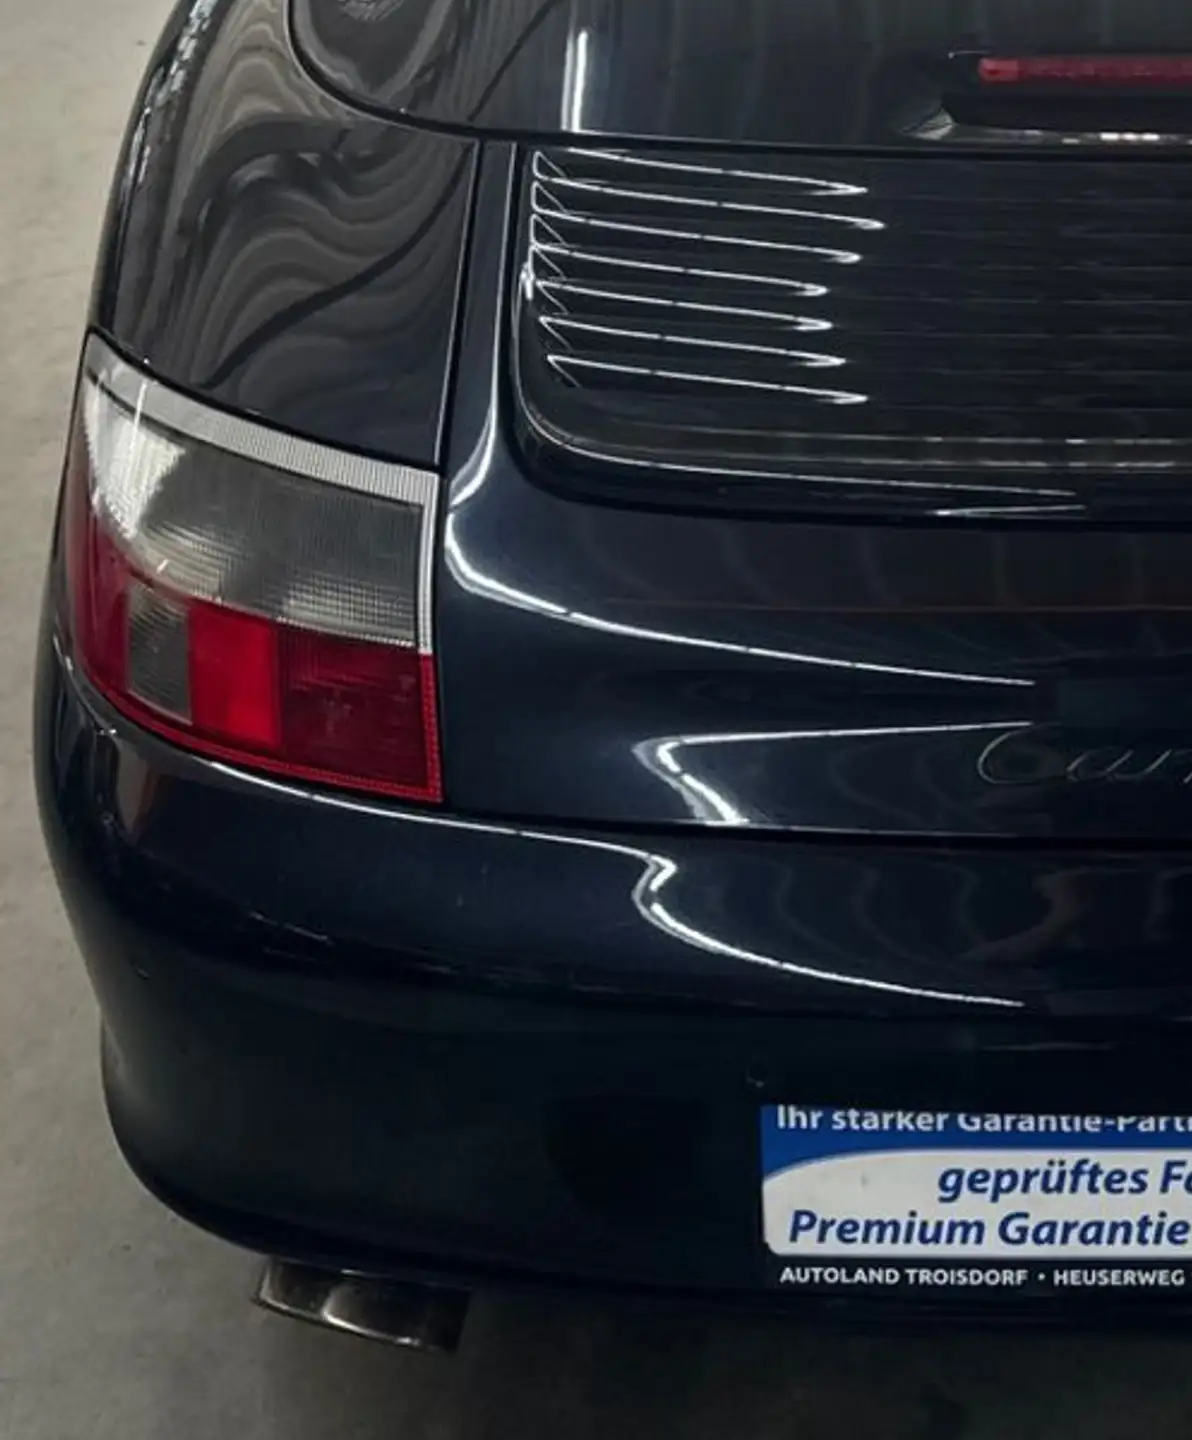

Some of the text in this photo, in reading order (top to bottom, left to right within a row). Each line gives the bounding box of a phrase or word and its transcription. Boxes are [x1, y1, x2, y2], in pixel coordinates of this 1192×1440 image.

[777, 1104, 823, 1129] Ihr
[831, 1109, 949, 1131] starker
[938, 1159, 1149, 1202] geprüftes
[789, 1210, 1191, 1246] Premium Garantie
[780, 1267, 899, 1284] AUTOLAND
[905, 1268, 1028, 1286] TROISDORF
[1053, 1268, 1185, 1286] HEUSERWEG
